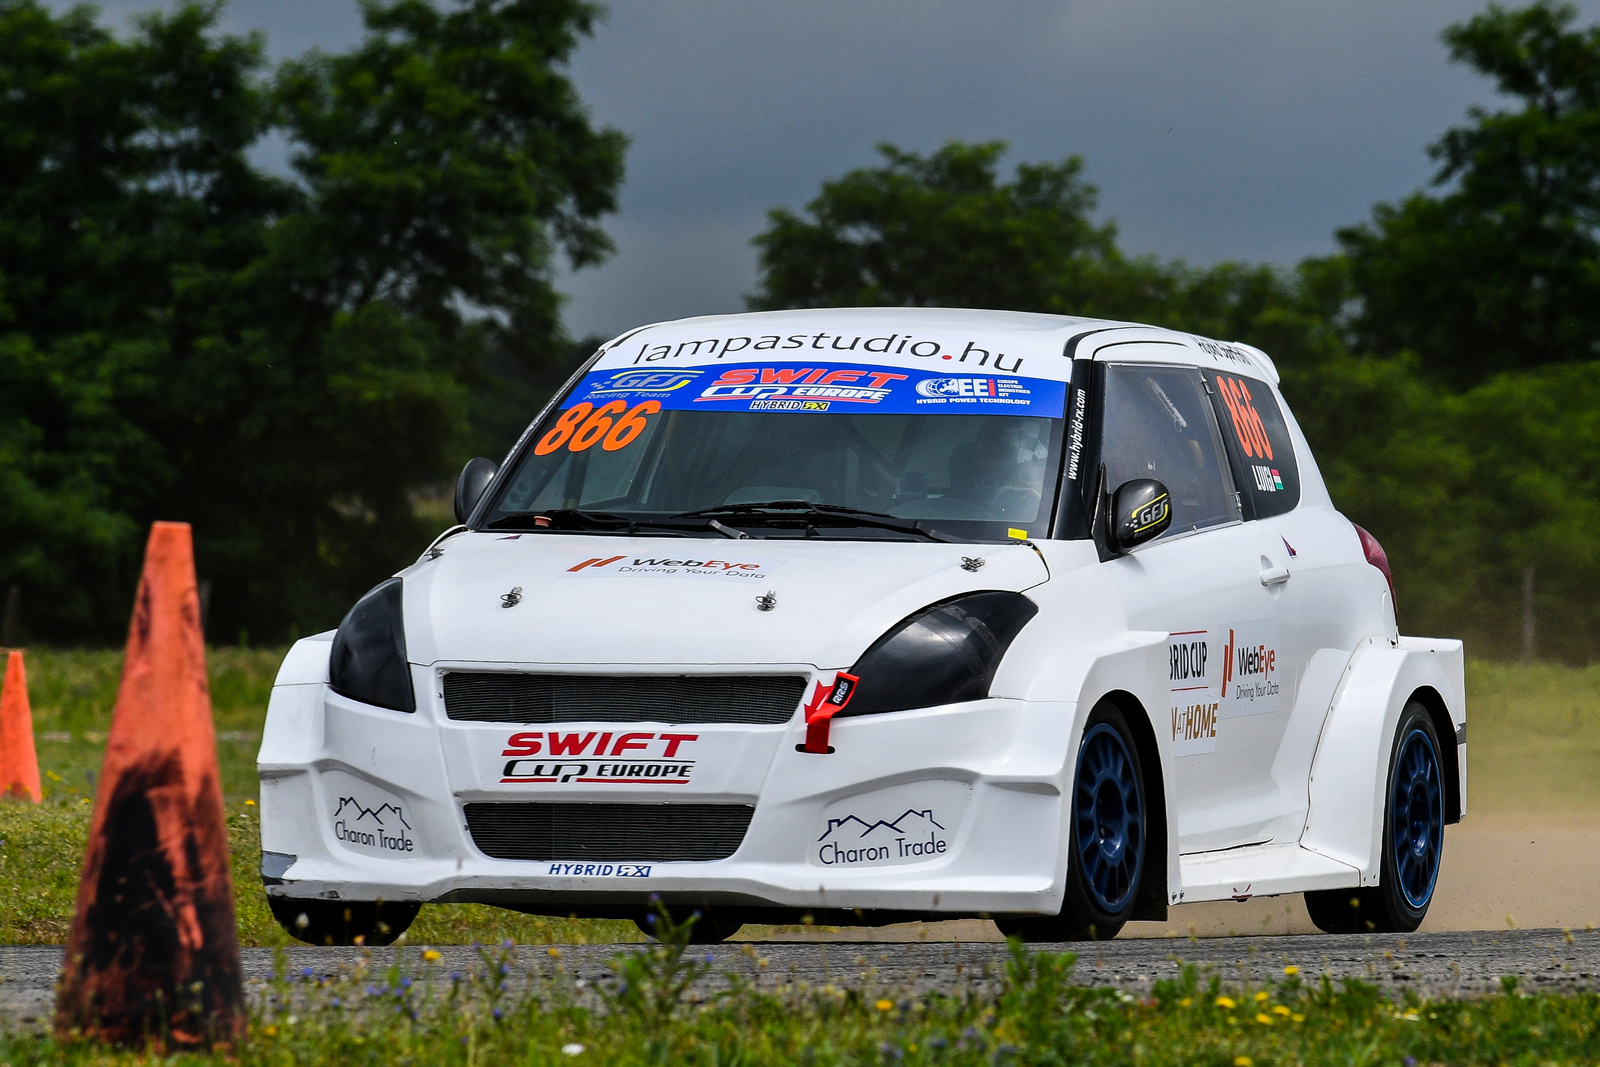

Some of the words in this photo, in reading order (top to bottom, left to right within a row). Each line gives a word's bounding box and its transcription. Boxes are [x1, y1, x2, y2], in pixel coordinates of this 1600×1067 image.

[632, 332, 1024, 373] lampastudio.hu
[711, 368, 909, 388] SWIFT
[583, 392, 628, 400] Racing
[632, 391, 671, 399] Team
[792, 387, 886, 400] EUROPE
[979, 398, 1031, 406] TECHNOLOGY
[749, 401, 800, 410] HYBRID
[534, 400, 661, 456] 866
[1216, 375, 1274, 461] 866
[1068, 388, 1086, 480] www.hybrid-rx.com
[618, 566, 677, 574] Driving
[725, 570, 766, 579] Data
[632, 558, 761, 571] WebEye
[1237, 644, 1276, 680] WebEye
[832, 680, 849, 704] RRS
[1236, 684, 1255, 701] Driving
[1254, 682, 1267, 698] Your
[1266, 680, 1280, 696] Data
[501, 732, 700, 757] SWIFT
[596, 763, 695, 778] EUROPE
[335, 819, 376, 847] Charon
[377, 828, 414, 852] Trade
[819, 841, 890, 865] Charon
[895, 831, 947, 857] Trade
[548, 863, 613, 876] HYBRID
